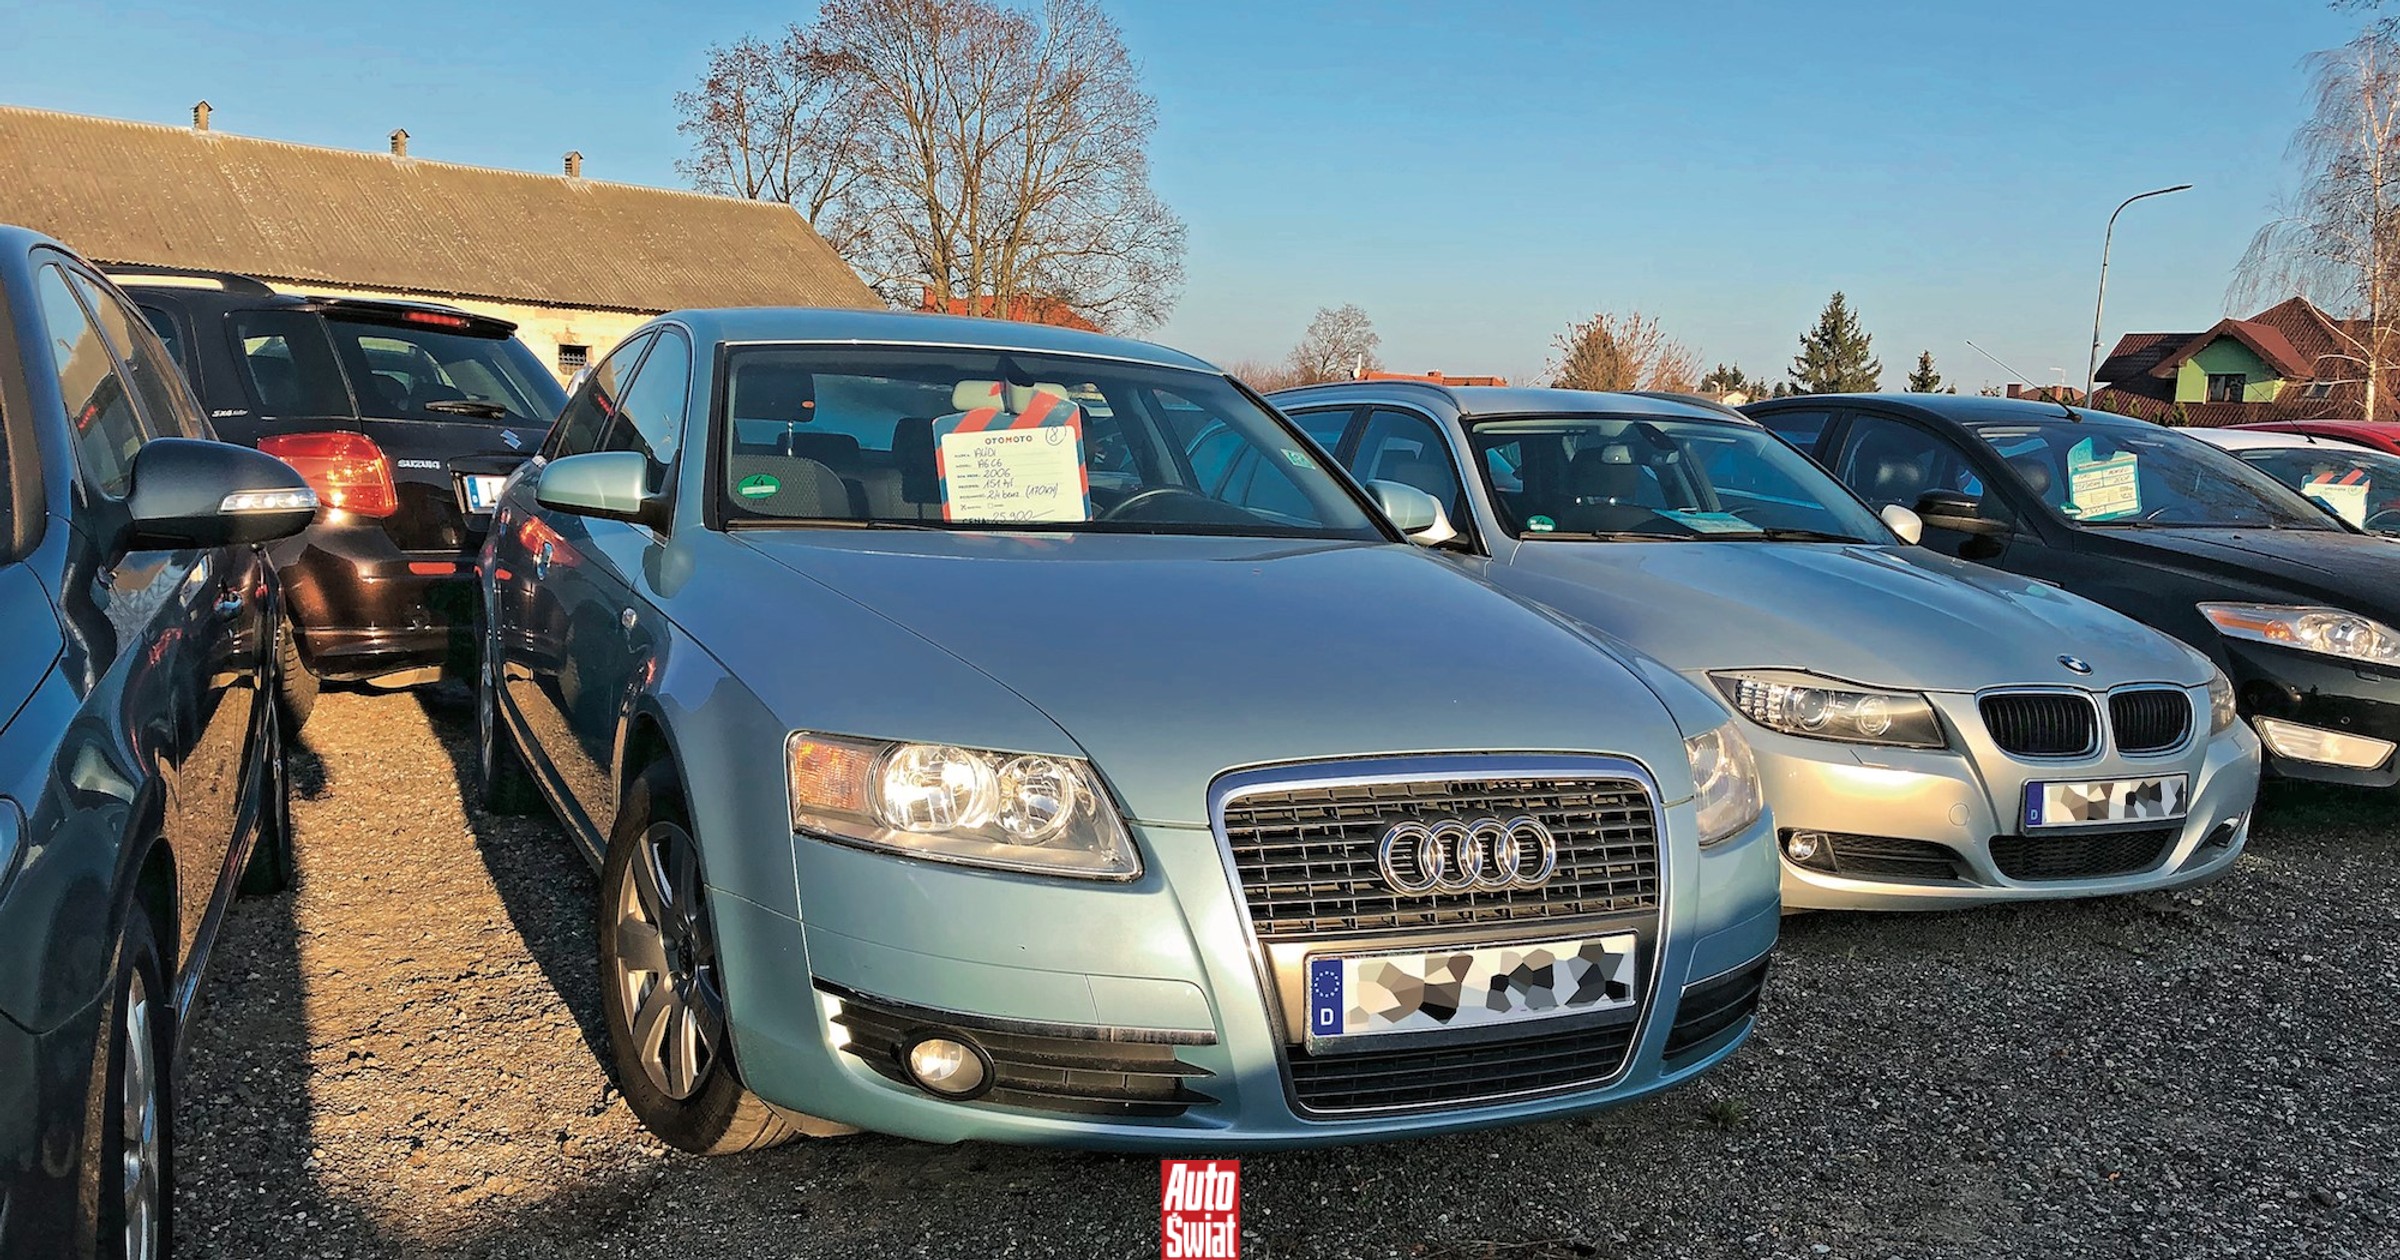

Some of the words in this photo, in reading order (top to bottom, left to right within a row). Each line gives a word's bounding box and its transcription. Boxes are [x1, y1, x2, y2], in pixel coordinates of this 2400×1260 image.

[985, 435, 1033, 445] OTOMOTO
[983, 468, 1011, 478] 2006
[2030, 808, 2039, 821] D
[1320, 1008, 1334, 1026] D
